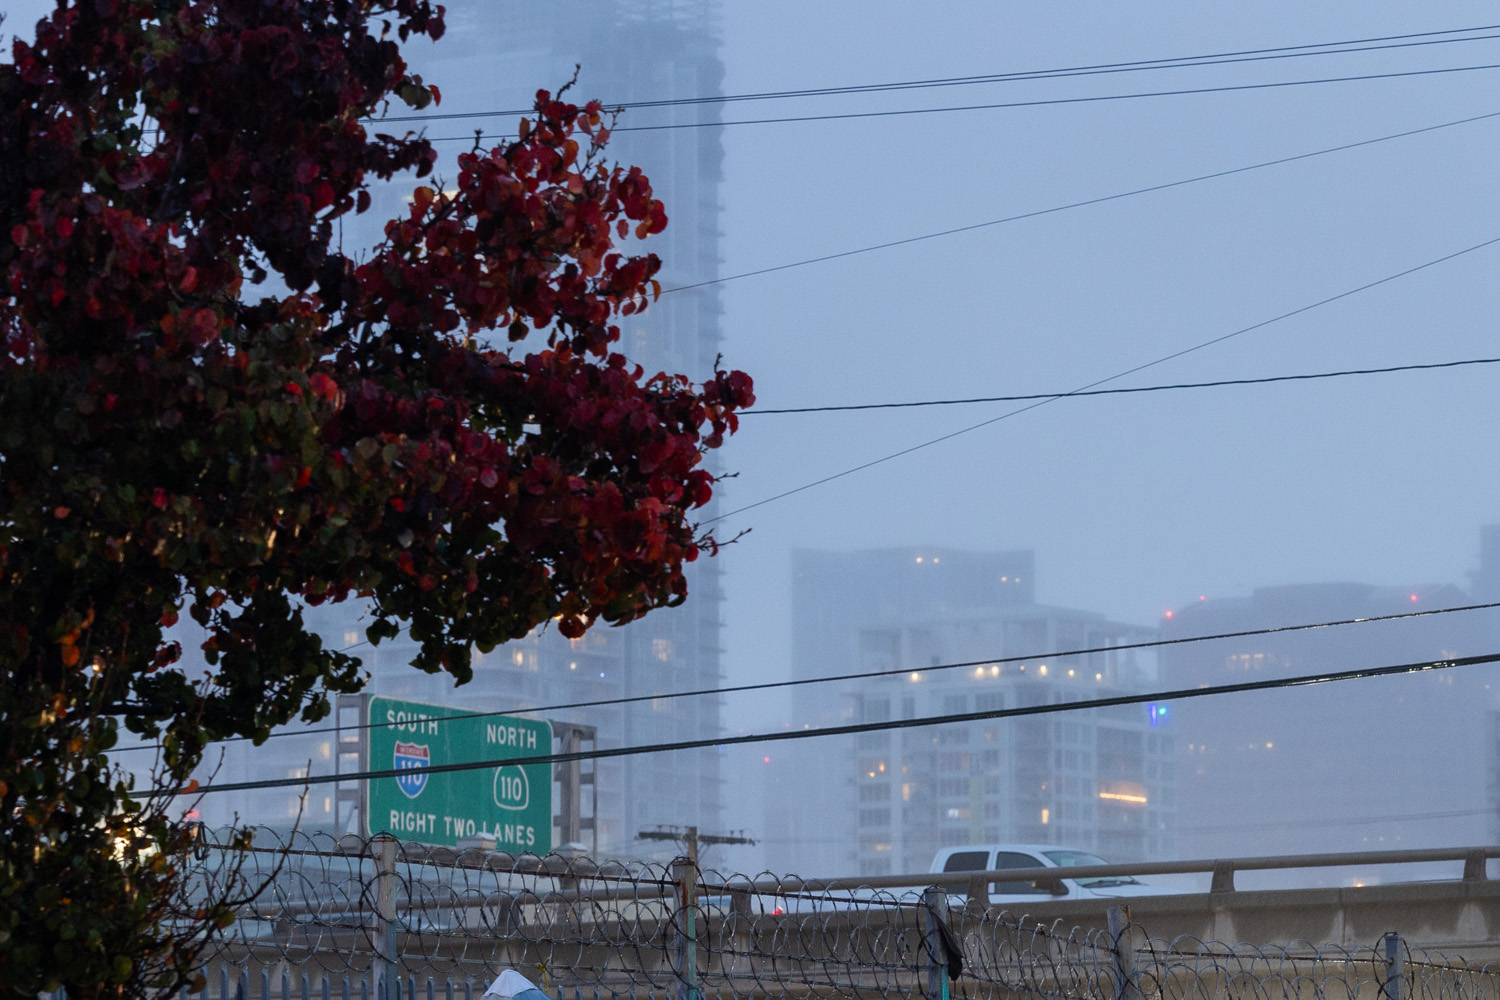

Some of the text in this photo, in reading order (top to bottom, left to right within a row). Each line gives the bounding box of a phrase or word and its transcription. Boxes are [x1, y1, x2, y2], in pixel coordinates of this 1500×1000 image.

[387, 709, 536, 750] SOUTH NORTH
[401, 760, 424, 786] 110
[501, 775, 522, 800] 110
[390, 810, 436, 834] RIGHT
[444, 817, 475, 838] TWO
